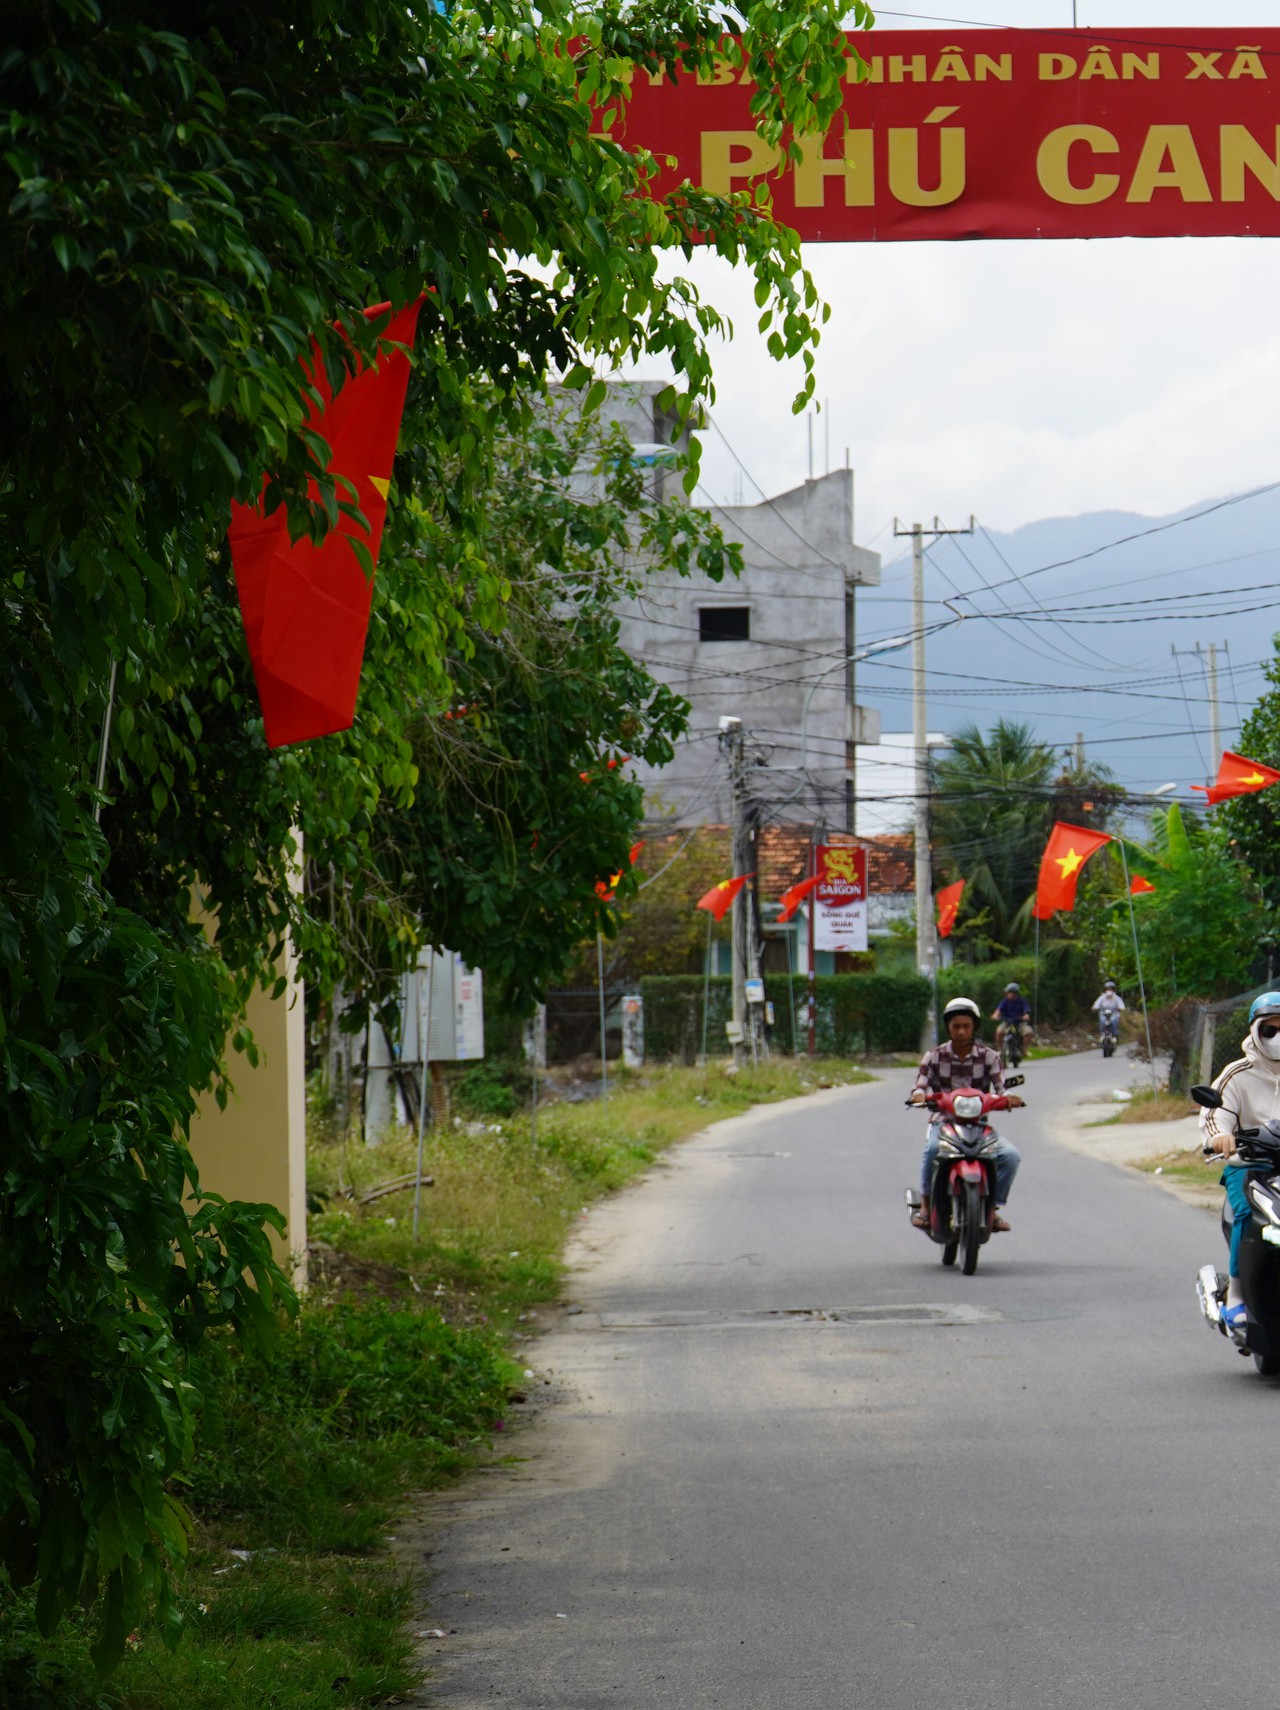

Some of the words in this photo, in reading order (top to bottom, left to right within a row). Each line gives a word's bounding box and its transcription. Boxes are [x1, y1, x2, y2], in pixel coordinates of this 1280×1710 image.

[846, 45, 1013, 83] NHÂN
[1038, 44, 1160, 81] DÂN
[1184, 44, 1268, 80] XÃ
[701, 105, 966, 208] PHÚ
